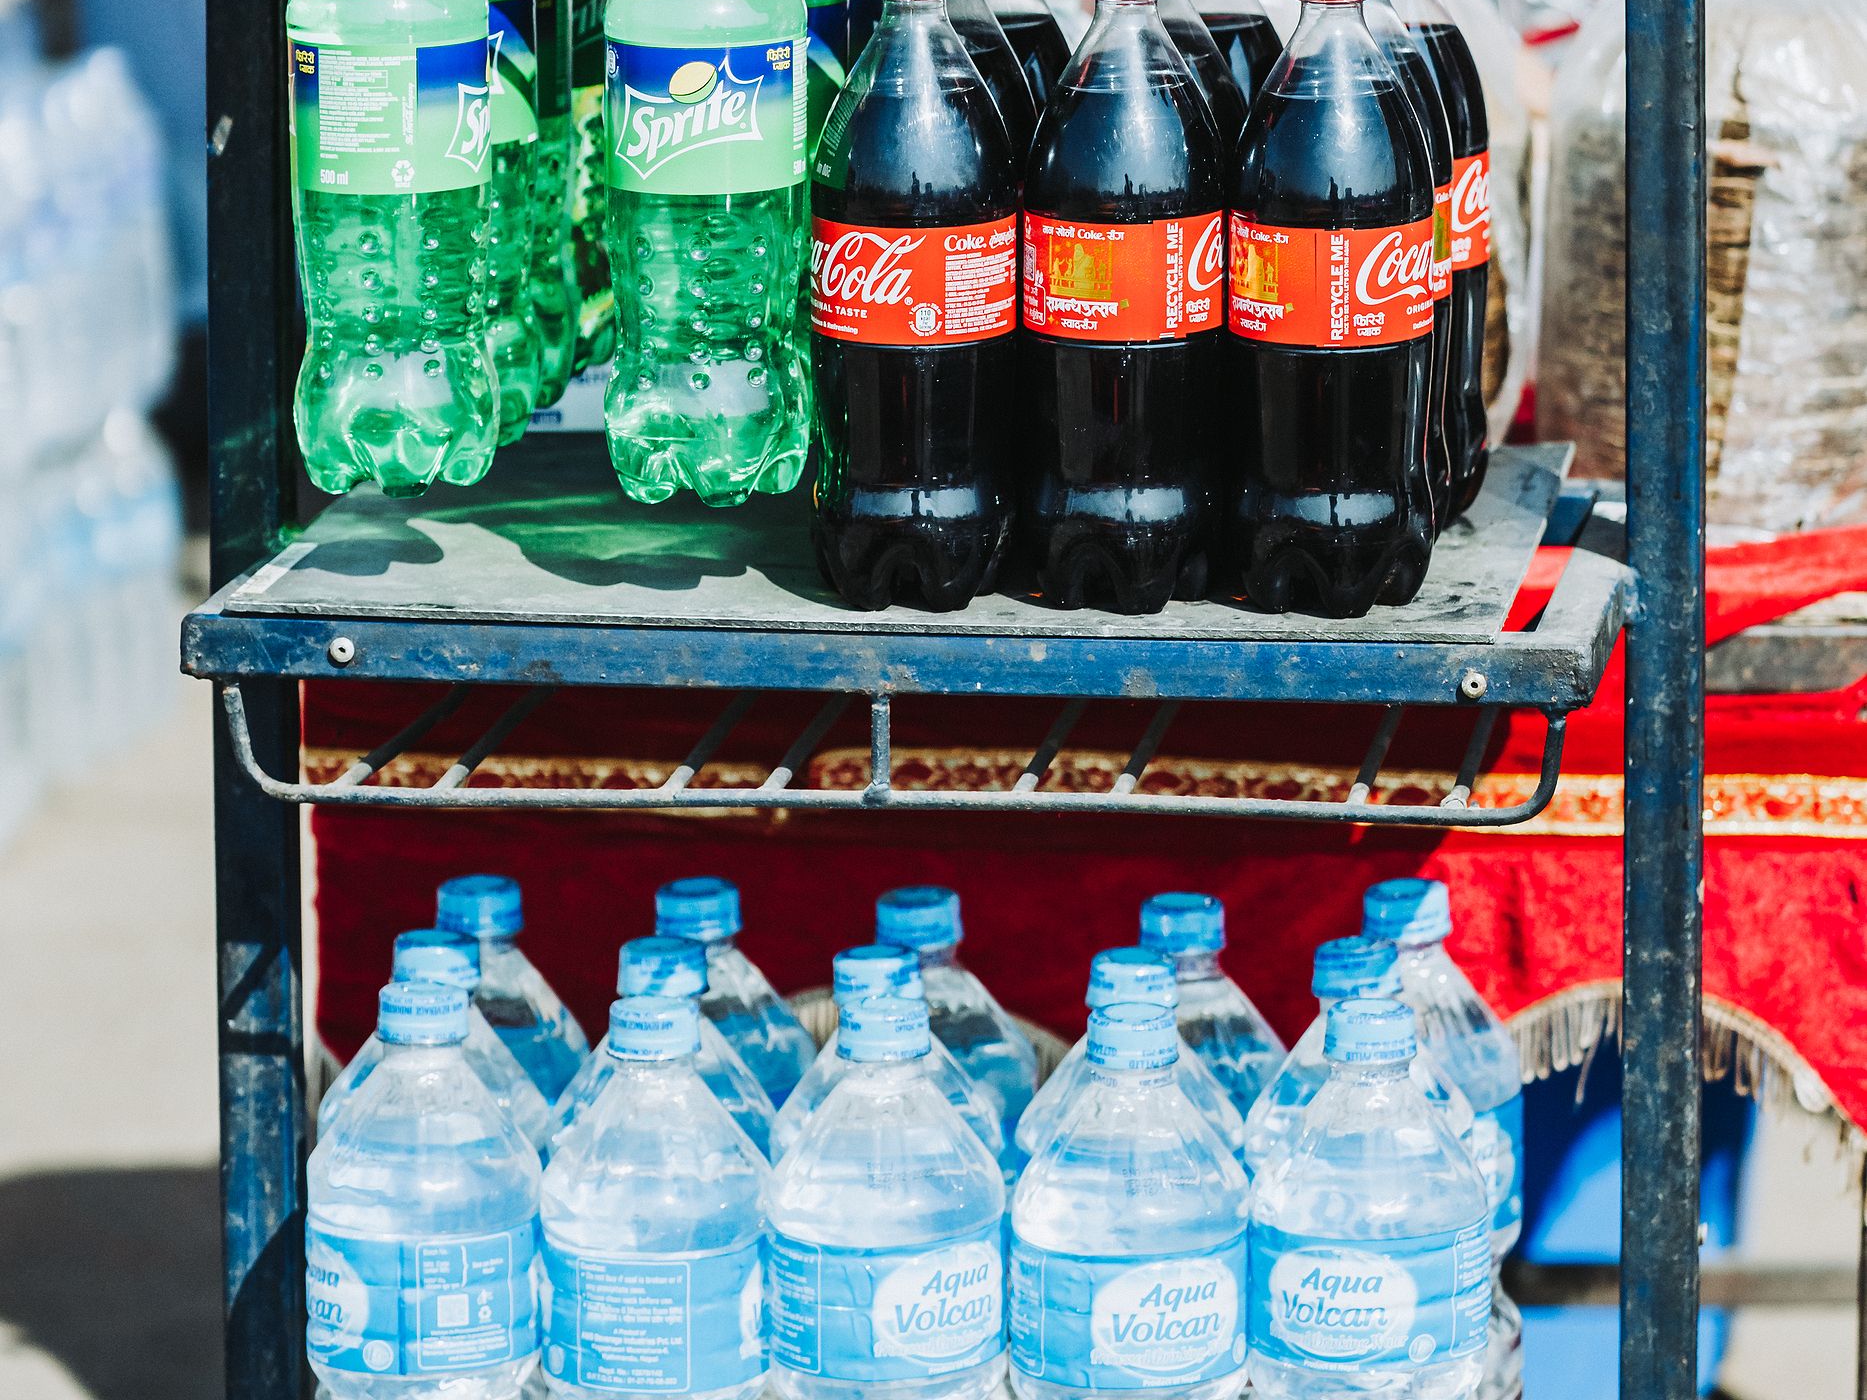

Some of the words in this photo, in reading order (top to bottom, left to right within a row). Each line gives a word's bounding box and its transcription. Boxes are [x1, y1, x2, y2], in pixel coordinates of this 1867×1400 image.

[626, 80, 747, 163] Sprite
[320, 169, 336, 185] 500
[337, 170, 349, 184] ml
[1166, 222, 1179, 250] ME
[1330, 234, 1344, 261] ME
[811, 231, 927, 305] a-Cola
[1355, 231, 1434, 306] Coca-
[1166, 252, 1179, 329] RECYCLE
[1330, 264, 1344, 341] RECYCLE
[1406, 298, 1434, 315] ORIGIN
[834, 305, 868, 319] TASTE
[922, 1263, 989, 1297] Aqua
[1139, 1281, 1217, 1312] Aqua
[1300, 1267, 1384, 1300] Aqua
[309, 1298, 343, 1324] can
[895, 1294, 992, 1334] Volcan
[1282, 1290, 1389, 1328] Volcan
[1111, 1311, 1220, 1342] Volcan
